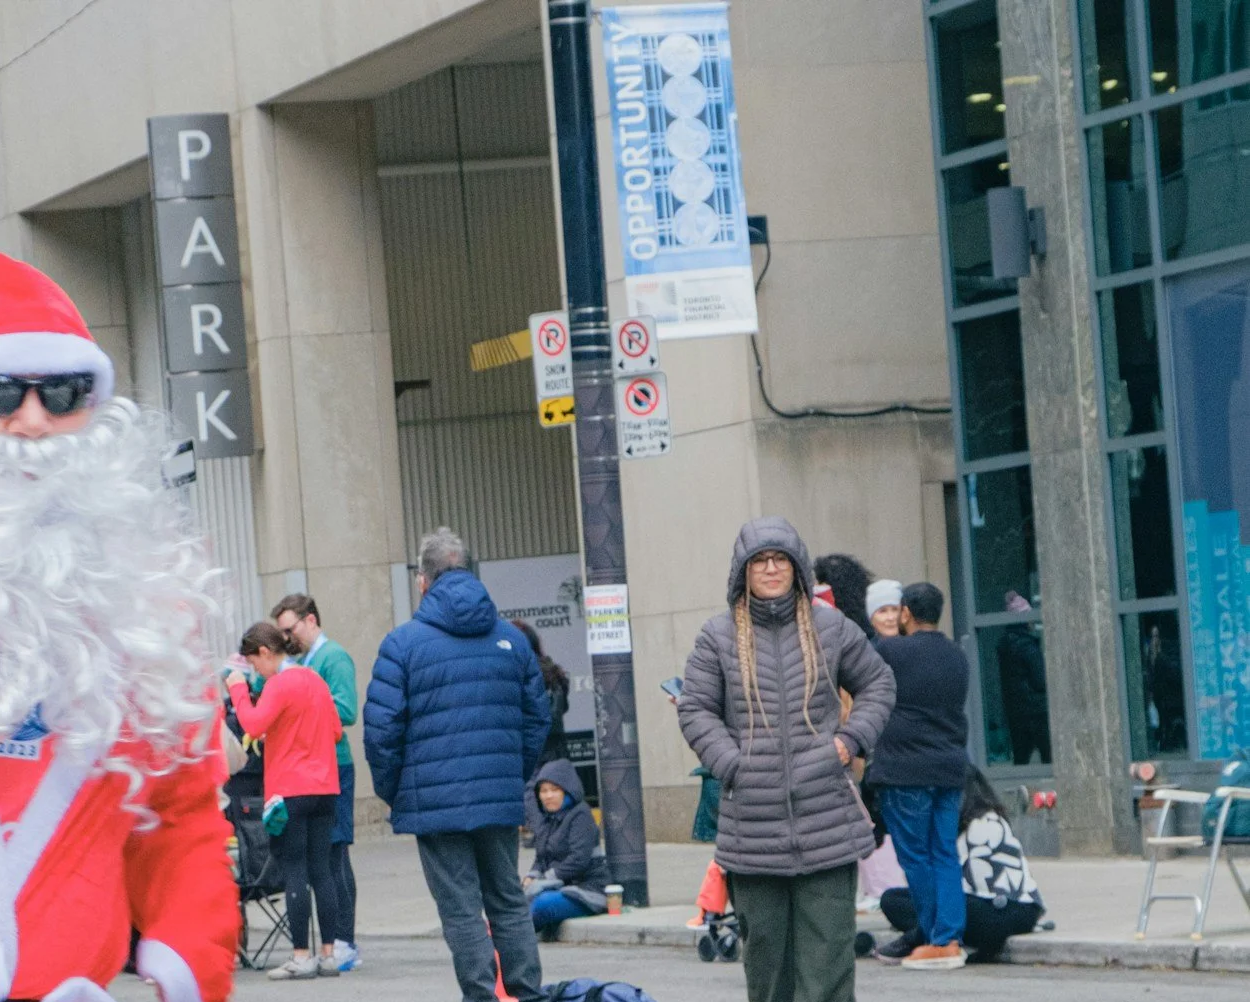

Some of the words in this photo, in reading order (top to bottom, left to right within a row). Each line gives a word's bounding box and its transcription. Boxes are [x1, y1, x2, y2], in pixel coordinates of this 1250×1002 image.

[609, 22, 658, 261] OPPORTUNITY
[176, 128, 238, 443] PARK
[683, 294, 722, 304] TORONTO
[544, 363, 566, 376] SNOW
[544, 378, 570, 391] ROUTE
[498, 603, 570, 619] commerce
[534, 615, 573, 629] court
[597, 629, 624, 640] STREET
